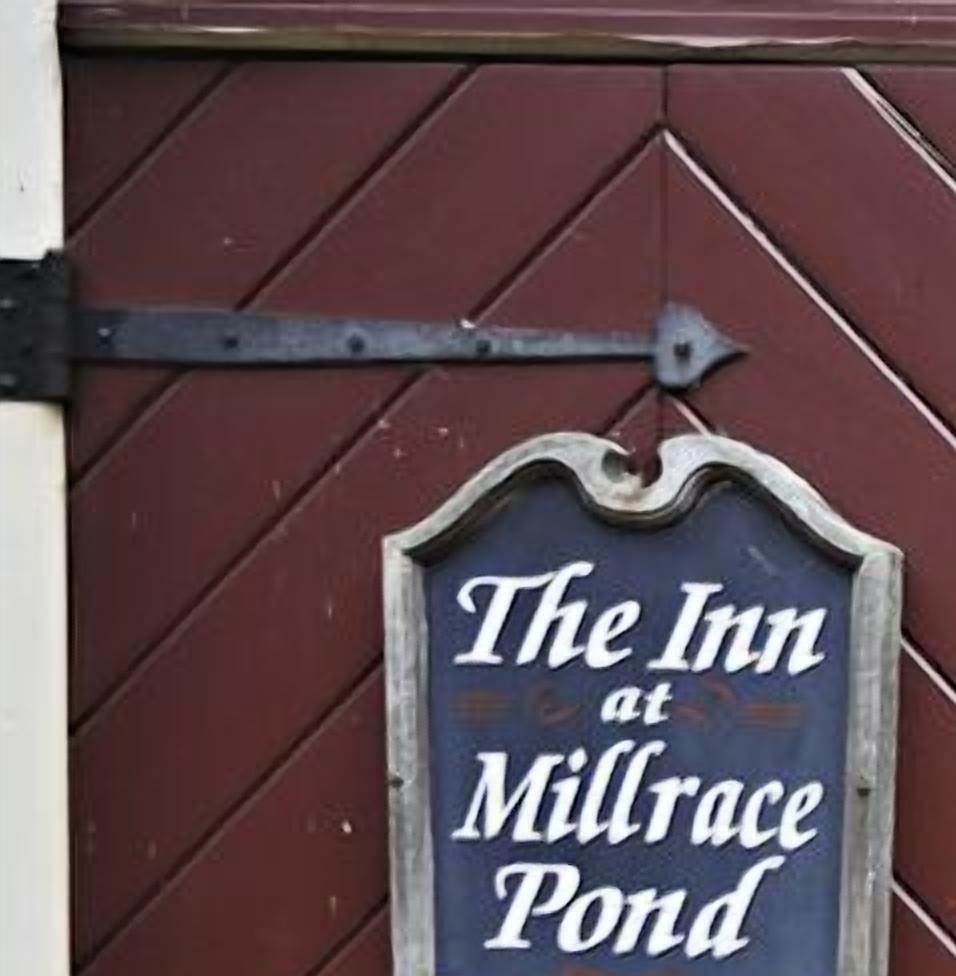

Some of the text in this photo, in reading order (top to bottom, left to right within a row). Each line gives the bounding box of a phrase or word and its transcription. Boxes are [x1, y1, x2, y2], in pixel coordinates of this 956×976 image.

[455, 562, 827, 675] The Inn
[600, 682, 673, 725] at
[452, 740, 825, 850] Millrace
[484, 856, 786, 959] Pond
